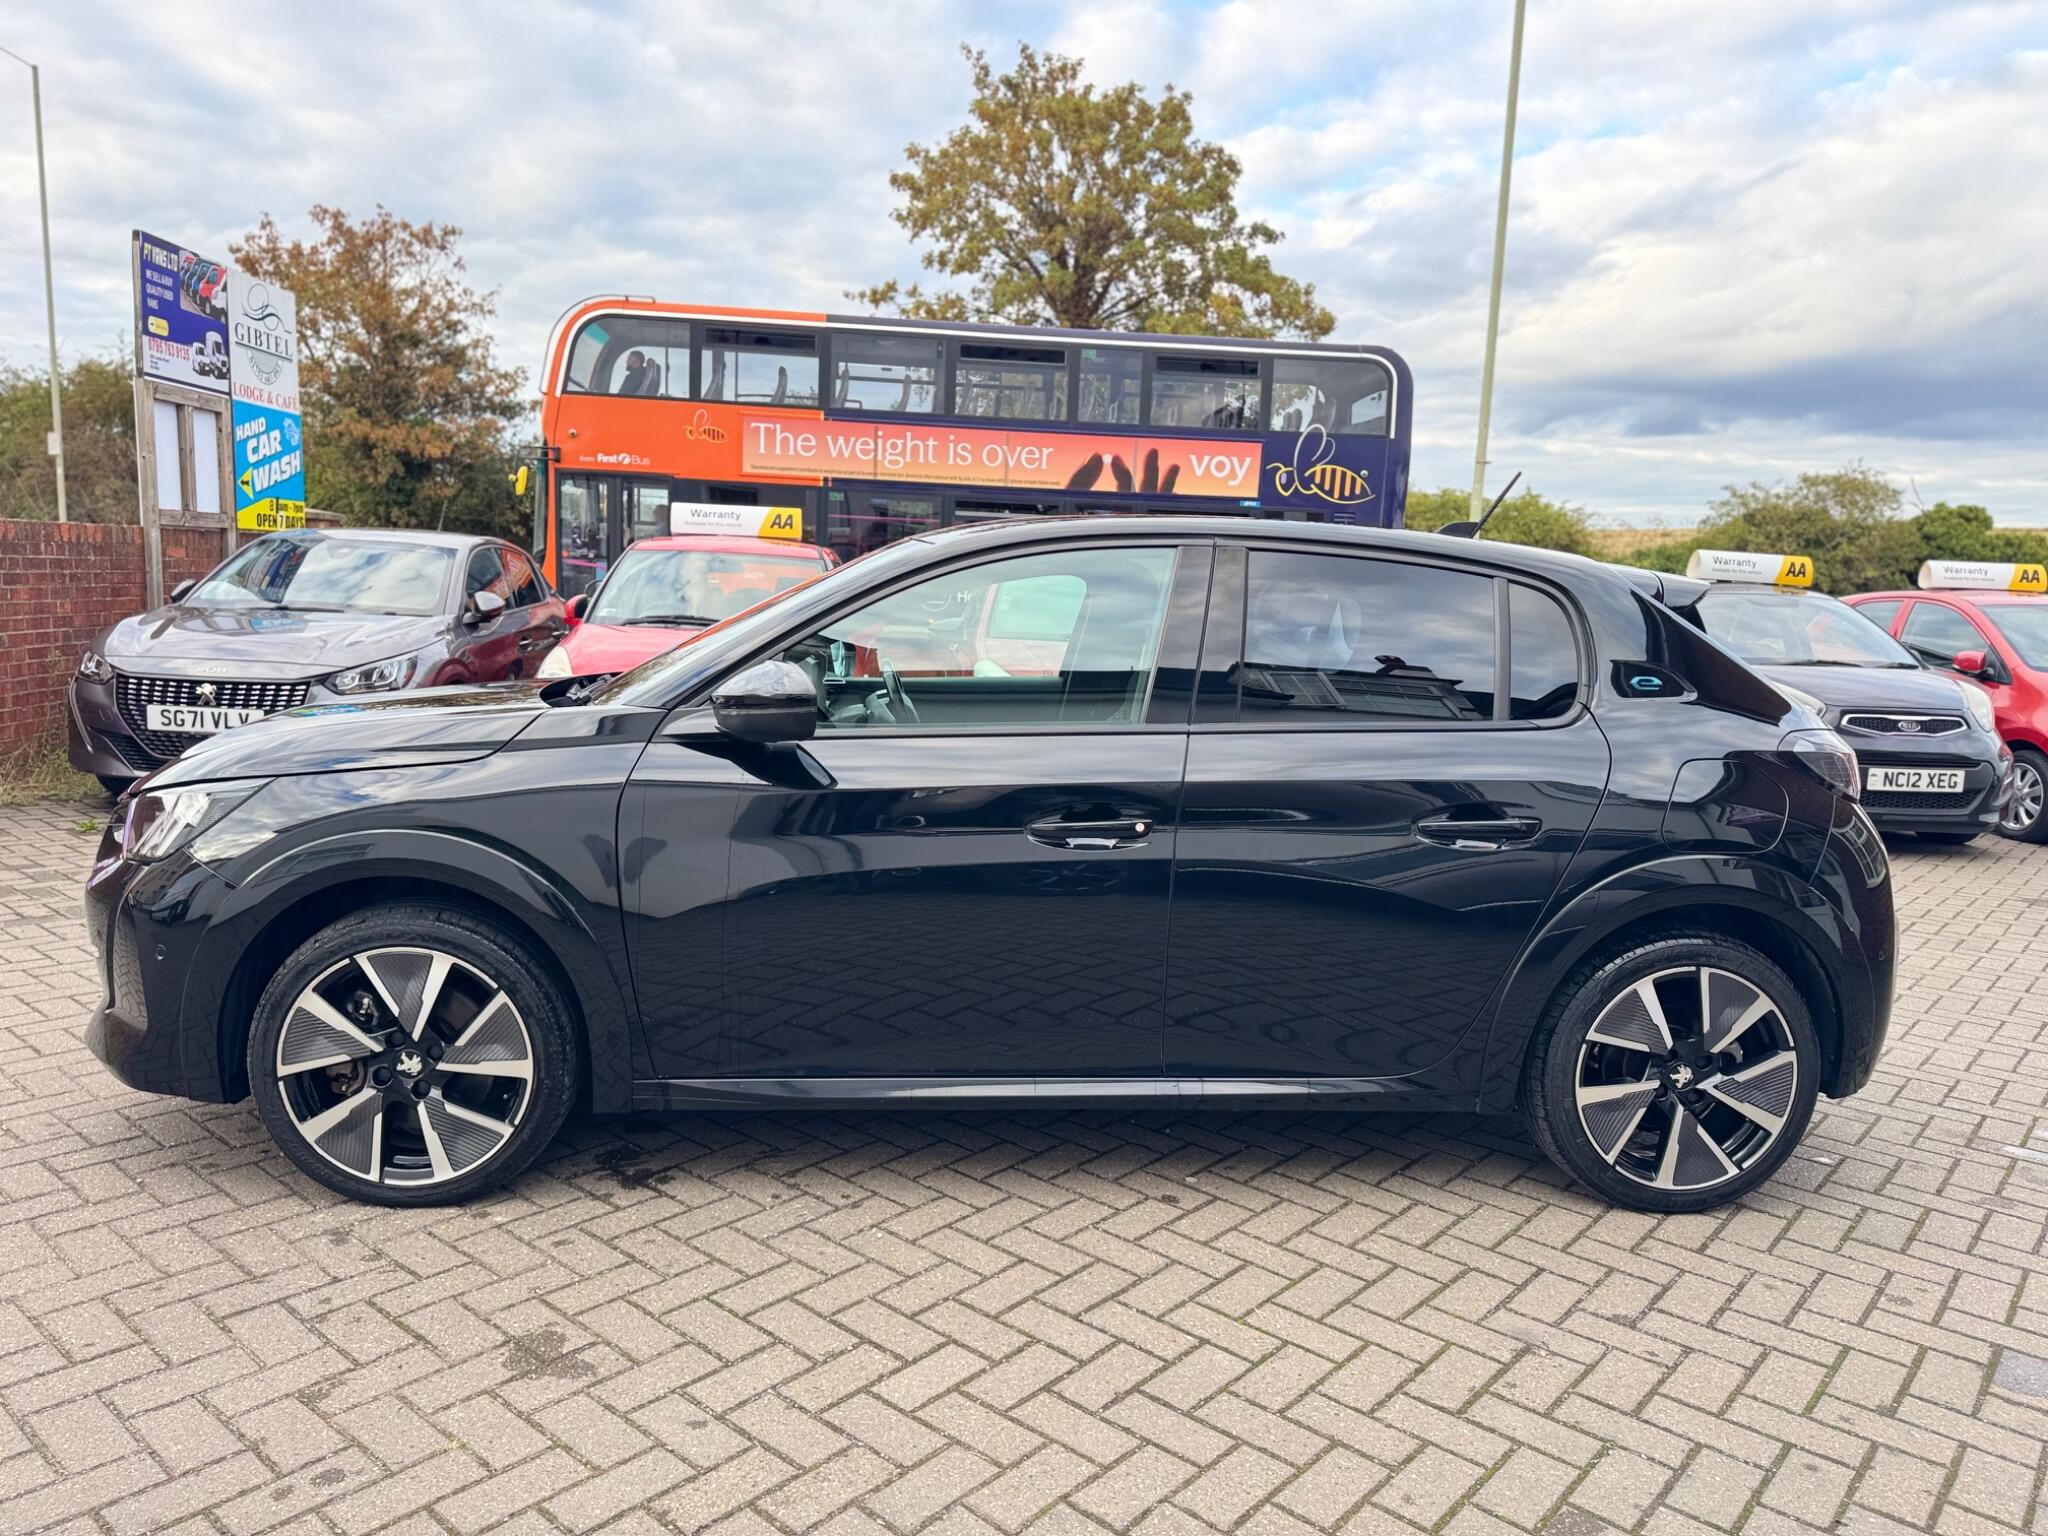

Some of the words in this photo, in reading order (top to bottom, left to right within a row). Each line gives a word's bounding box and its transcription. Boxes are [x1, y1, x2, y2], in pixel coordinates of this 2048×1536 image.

[235, 322, 293, 357] GIBTEL
[233, 382, 265, 403] LODGE
[267, 388, 273, 404] &
[236, 417, 266, 441] HAND
[246, 429, 282, 464] CAR
[750, 422, 817, 457] The
[826, 430, 938, 469] weight
[948, 434, 973, 465] is
[982, 444, 1055, 470] over
[631, 454, 651, 466] Bus
[253, 450, 301, 492] WASH
[1189, 454, 1253, 487] voy
[256, 513, 278, 528] OPEN
[279, 515, 284, 528] 7
[285, 516, 305, 528] DAYS
[690, 509, 742, 521] Warranty
[770, 513, 793, 529] AA
[1712, 556, 1758, 569] Warranty
[1785, 562, 1806, 578] AA
[1943, 565, 1989, 577] Warranty
[2018, 568, 2040, 583] AA
[160, 708, 204, 729] SG71
[1883, 771, 1922, 788] NC12
[1926, 772, 1959, 790] XEG
